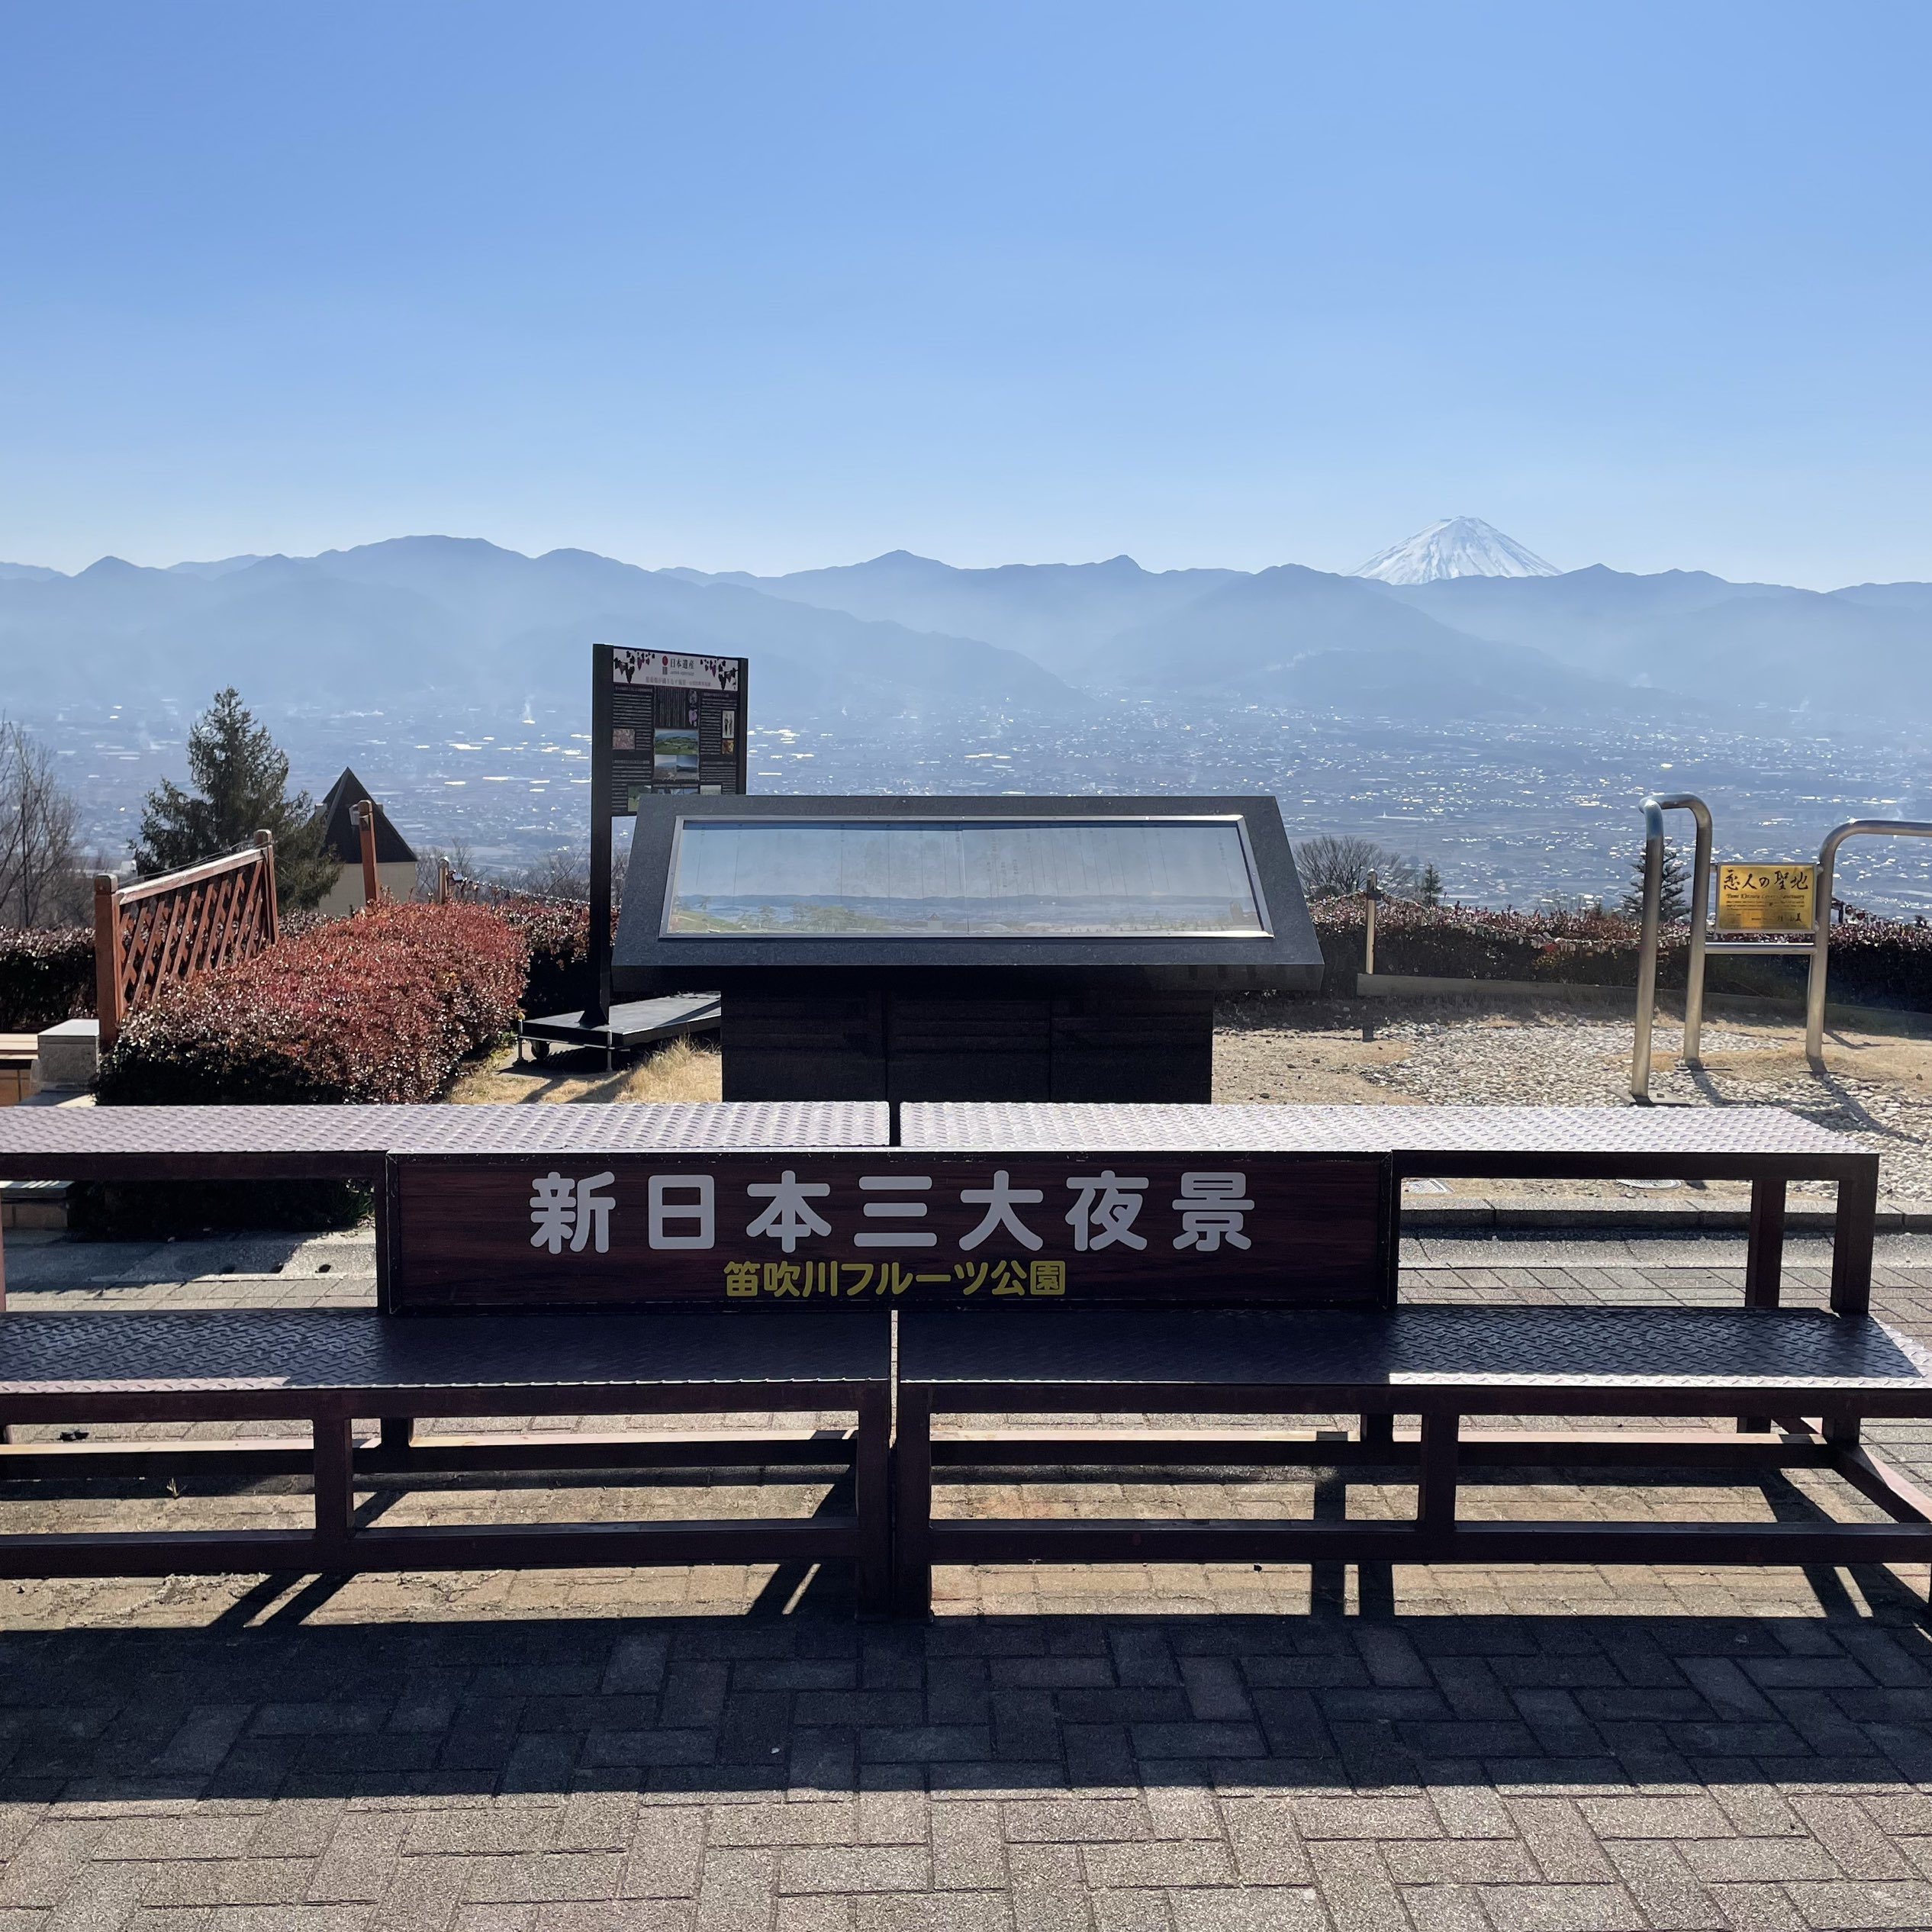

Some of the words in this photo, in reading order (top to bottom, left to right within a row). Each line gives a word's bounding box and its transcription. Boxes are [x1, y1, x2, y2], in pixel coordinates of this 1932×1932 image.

[670, 658, 695, 669] 日本遺産
[1723, 869, 1809, 890] 恋人の聖地
[530, 1170, 1254, 1254] 新日本三大夜景
[724, 1261, 1066, 1297] 笛吹川フルーツ公園
